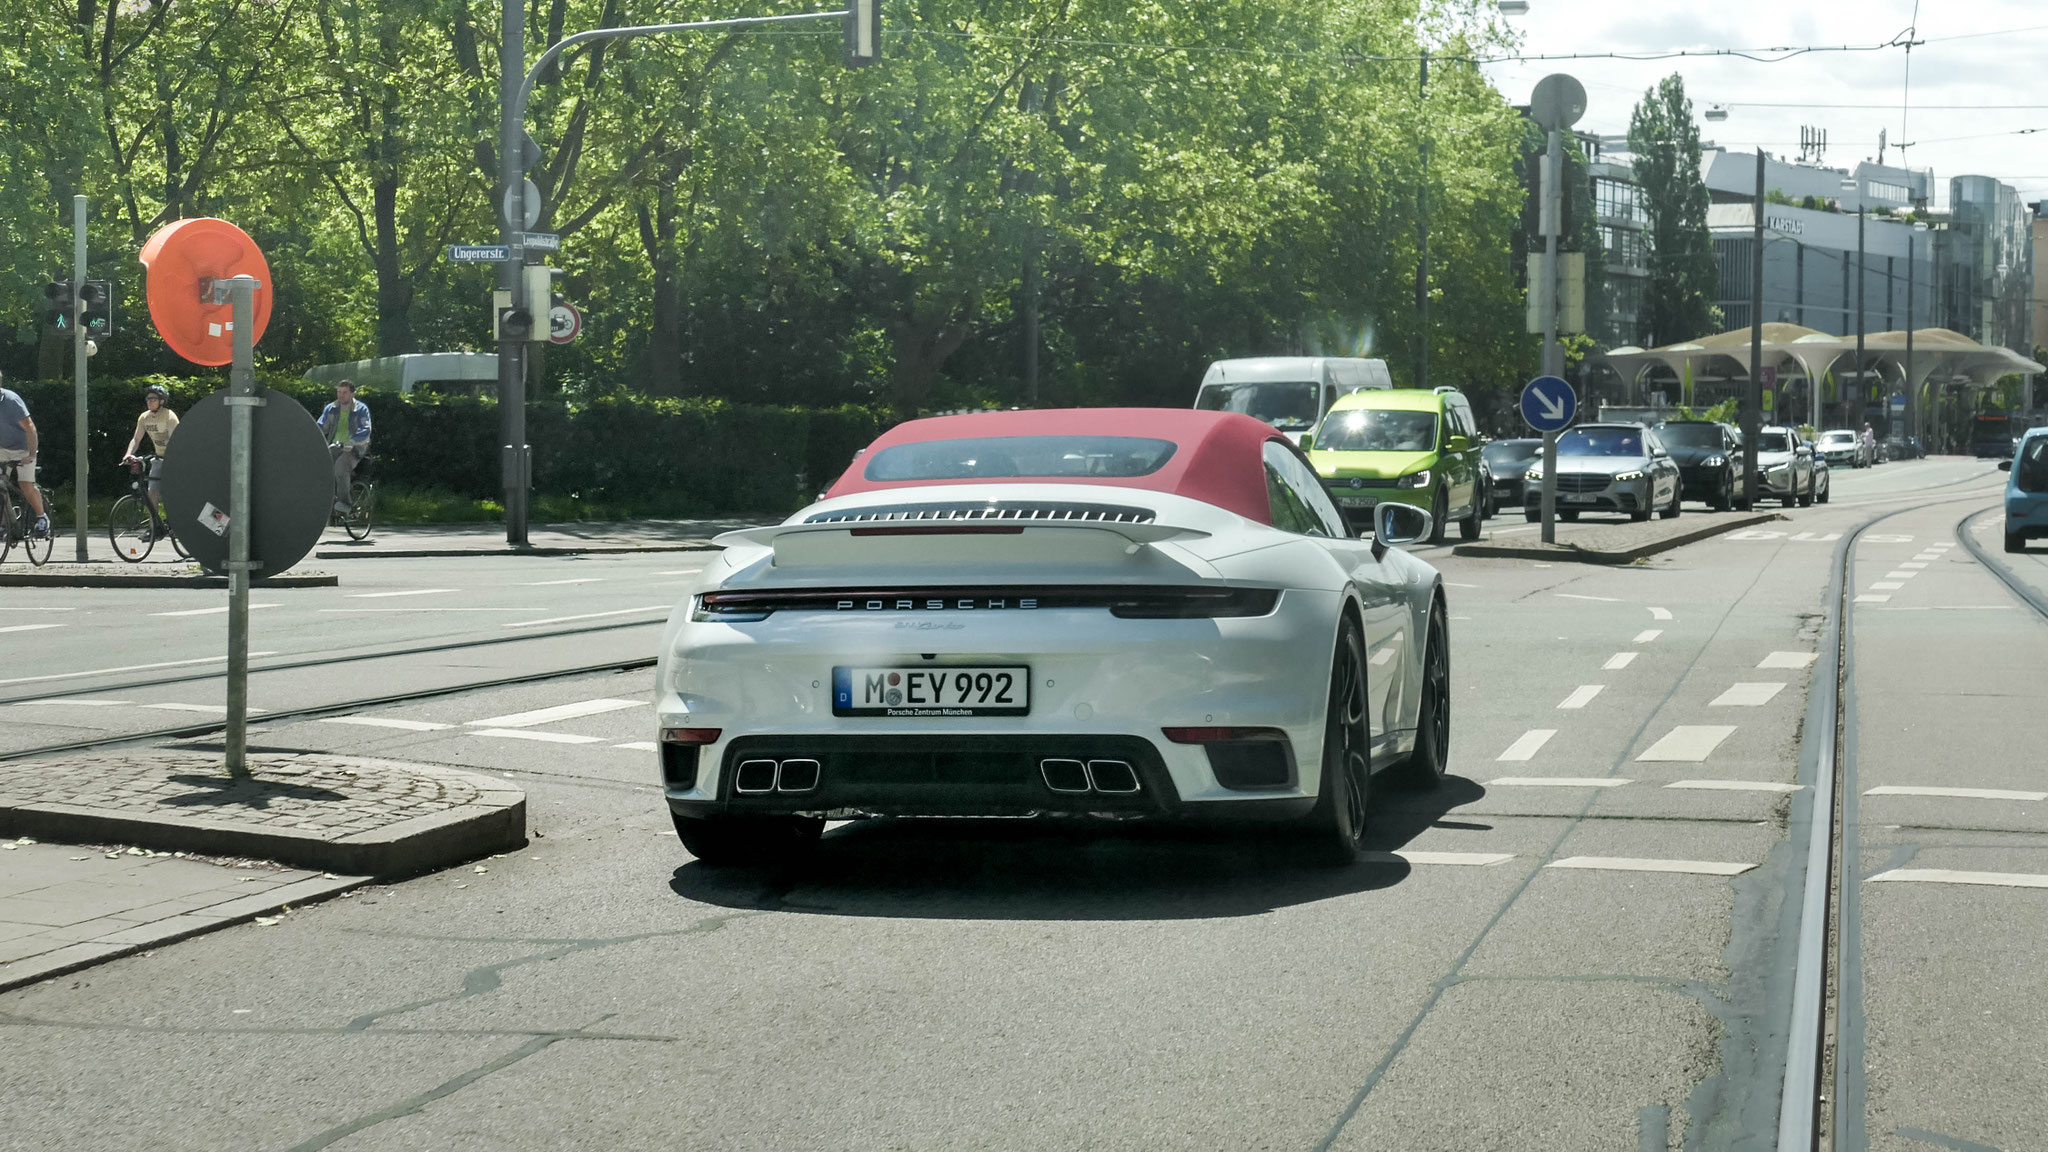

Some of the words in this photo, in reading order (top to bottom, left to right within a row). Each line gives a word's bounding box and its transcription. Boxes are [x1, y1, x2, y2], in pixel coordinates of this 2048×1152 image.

[1769, 216, 1805, 235] KARSTADT
[454, 247, 504, 260] Ungererstr.
[1724, 530, 1915, 543] BUS
[837, 599, 1038, 610] PORSCHE
[865, 673, 885, 704] M
[907, 673, 947, 704] EY
[955, 673, 1013, 704] 992
[839, 693, 848, 702] D
[887, 708, 914, 716] Porsche
[914, 708, 942, 716] Zentrum
[942, 708, 973, 716] München
